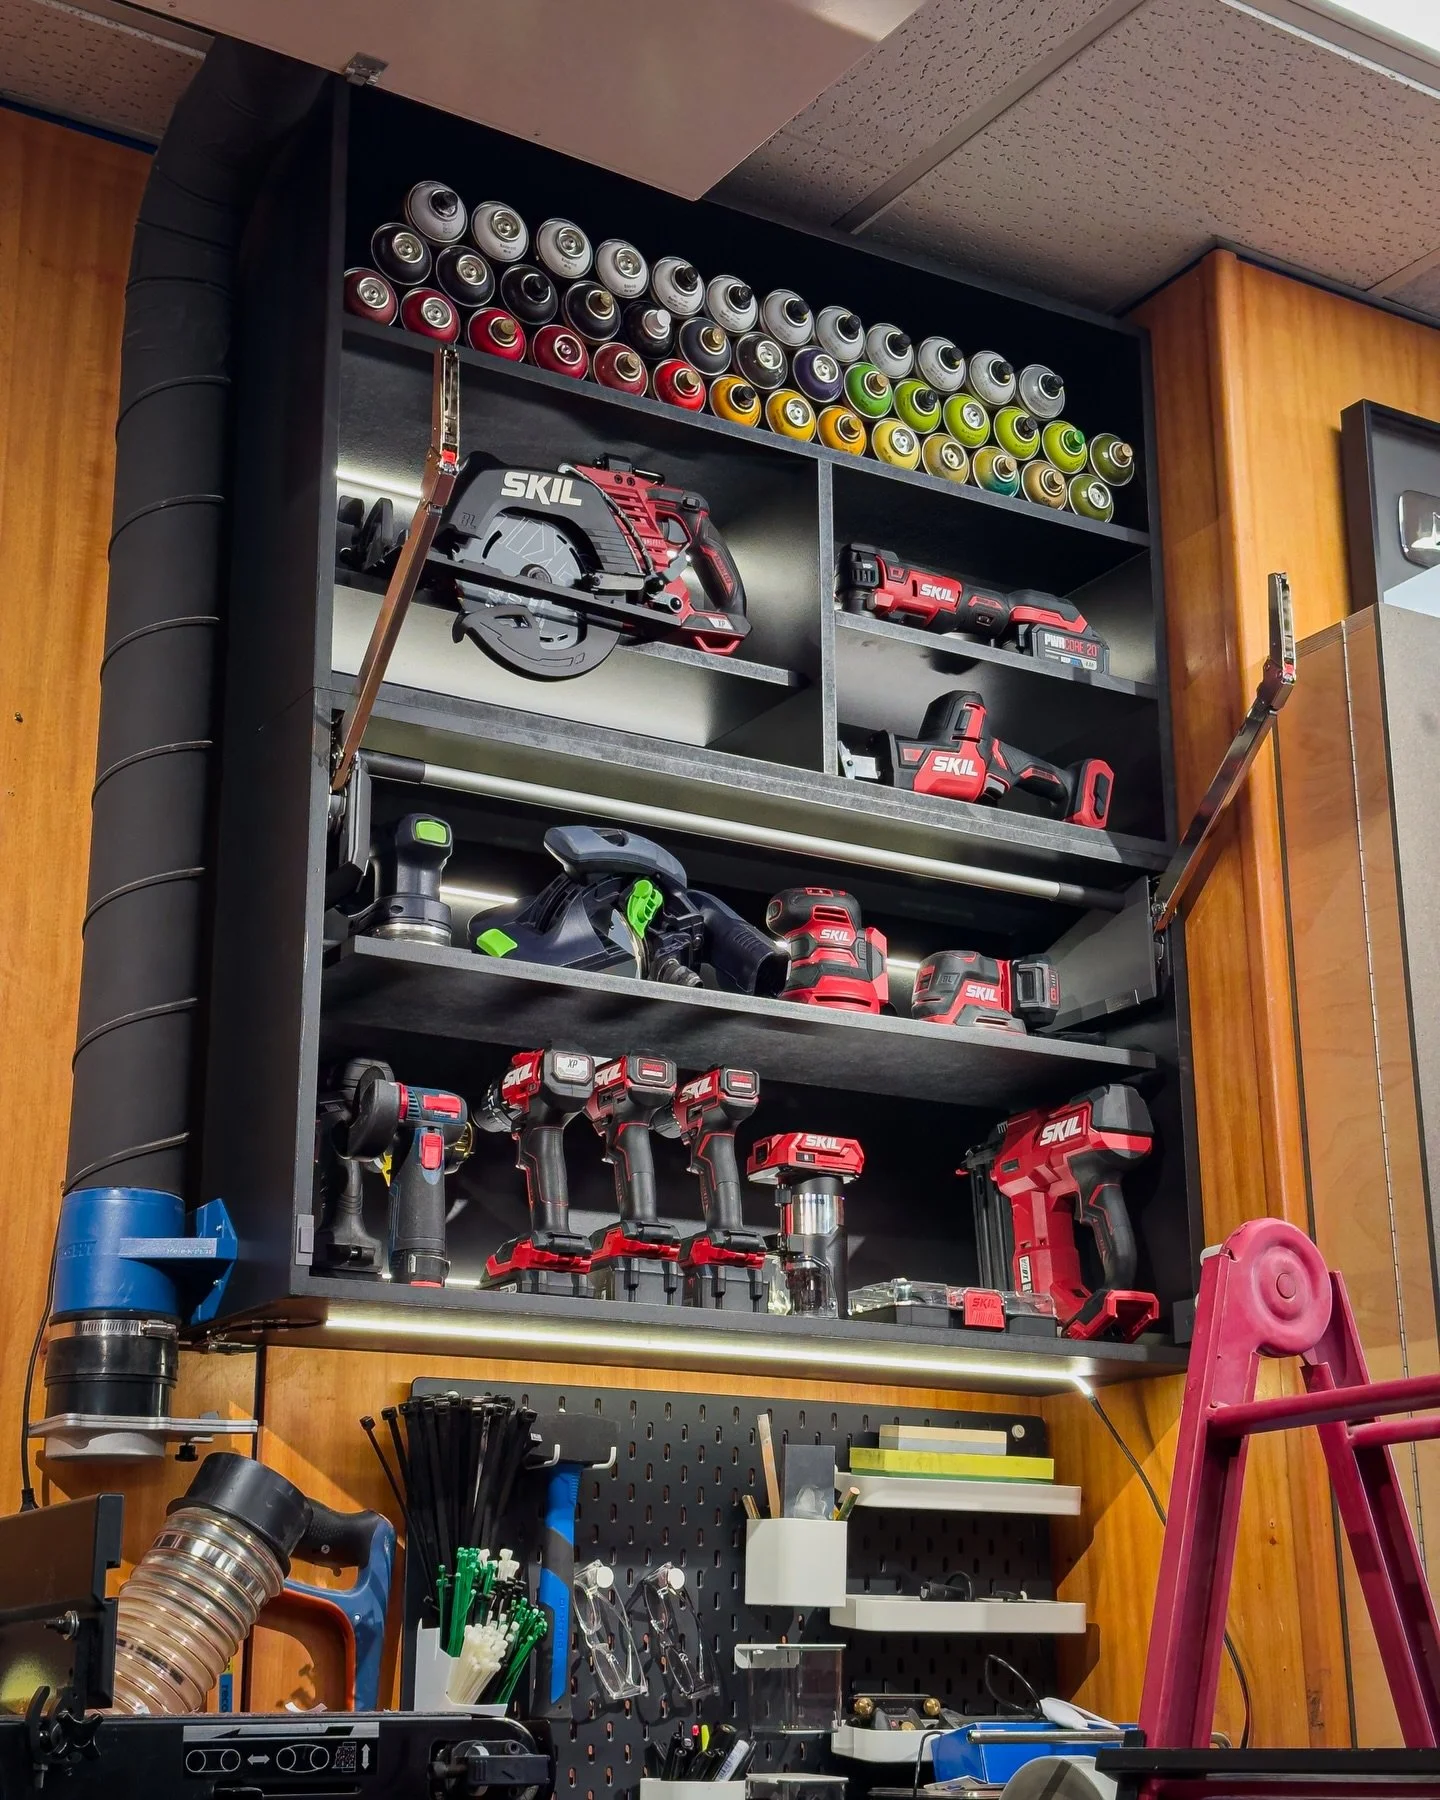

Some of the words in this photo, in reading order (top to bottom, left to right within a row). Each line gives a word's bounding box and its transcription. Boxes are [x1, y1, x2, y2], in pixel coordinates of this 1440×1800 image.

[501, 471, 582, 506] SKIL
[920, 584, 955, 602] SKIL
[1044, 633, 1084, 654] PWRCORE
[1086, 643, 1097, 657] 20
[932, 755, 978, 777] SKIL
[820, 929, 850, 941] SKIL
[965, 985, 998, 1002] SKIL
[567, 1059, 578, 1069] XP
[502, 1062, 533, 1089] SKIL
[680, 1076, 713, 1103] SKIL
[1040, 1115, 1082, 1147] SKIL
[805, 1134, 841, 1150] SKIL
[972, 1298, 998, 1309] SKIL
